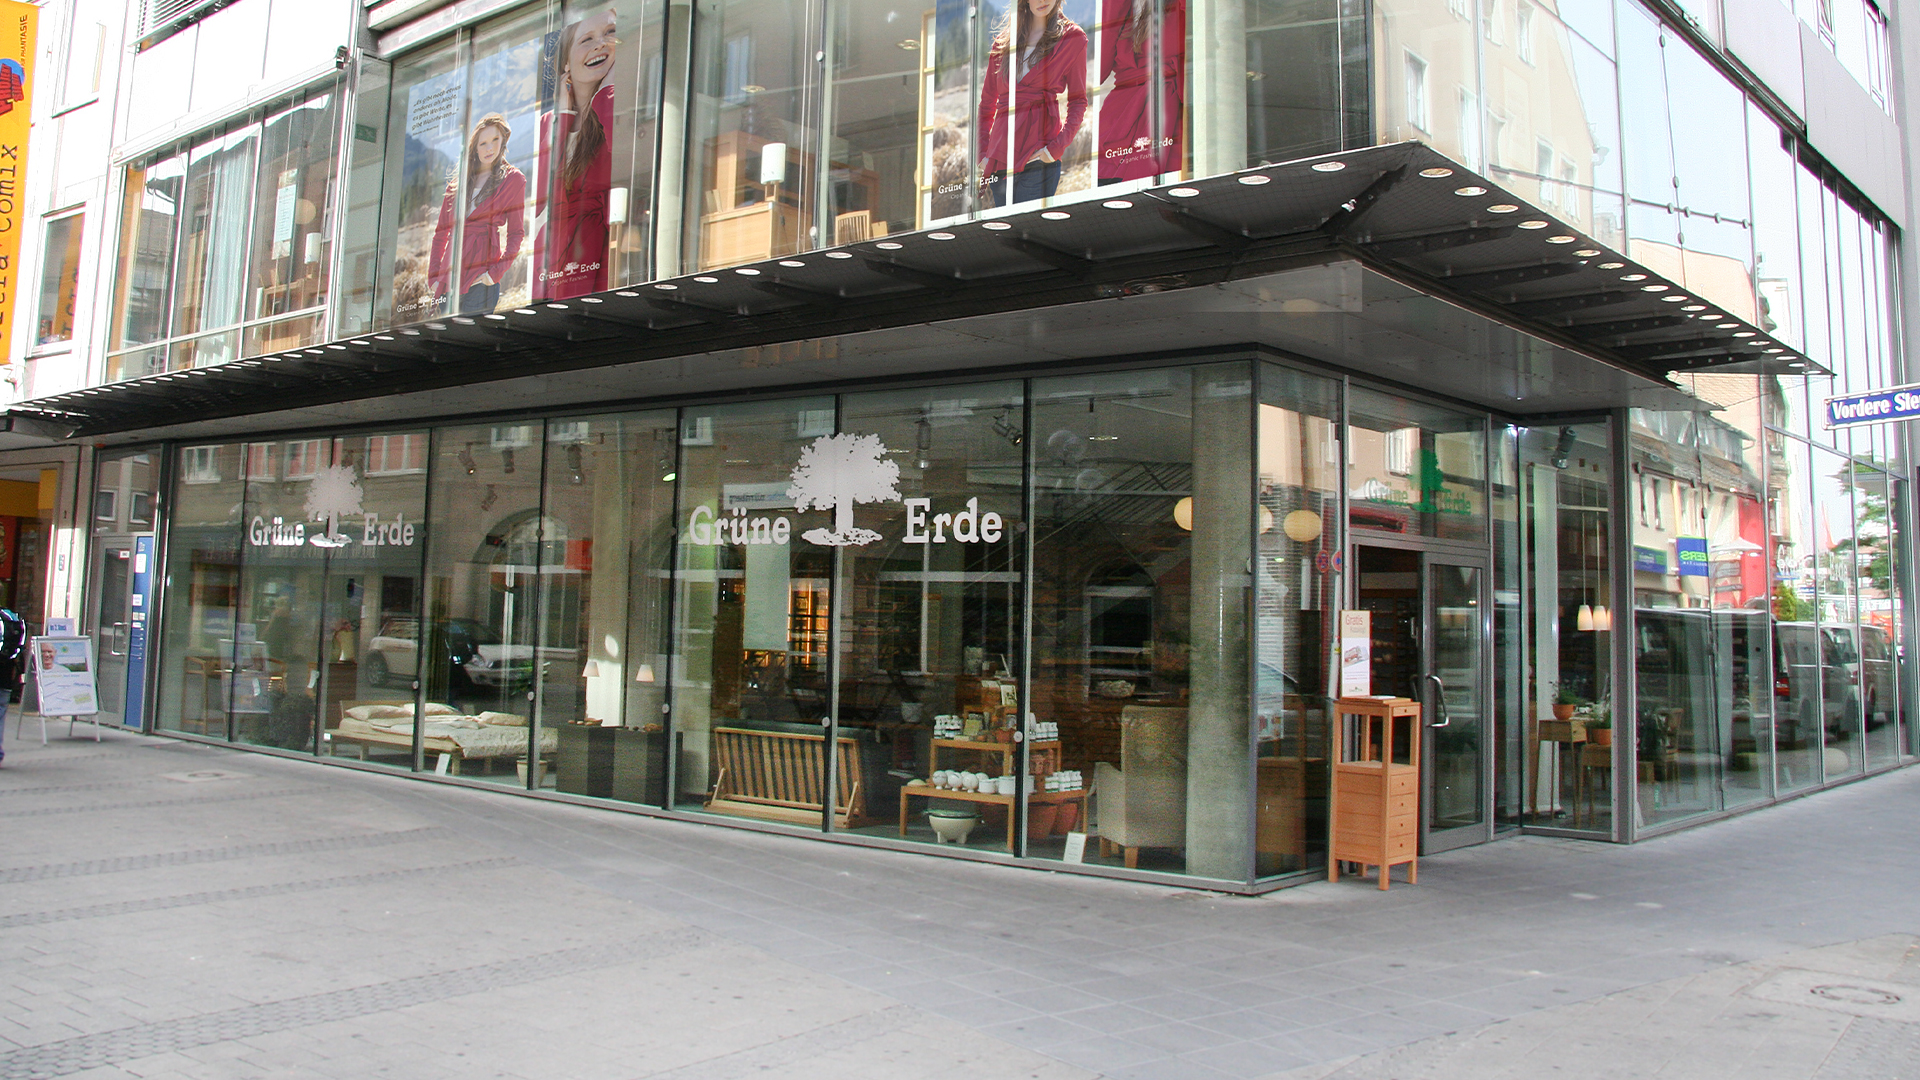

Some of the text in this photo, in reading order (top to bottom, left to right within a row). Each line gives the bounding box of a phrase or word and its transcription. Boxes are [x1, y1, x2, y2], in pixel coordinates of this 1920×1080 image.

[20, 14, 28, 58] PHANTASIE
[1105, 136, 1174, 159] Grüne Erde
[938, 183, 963, 195] Grüne
[979, 174, 999, 186] Erde
[538, 261, 601, 282] Grüne Erde
[396, 295, 447, 313] Grüne Erde
[1832, 392, 1920, 420] Vordere Ste
[250, 512, 415, 546] Grüne Erde
[689, 496, 1003, 546] Grüne Erde
[1345, 614, 1364, 626] Gratis
